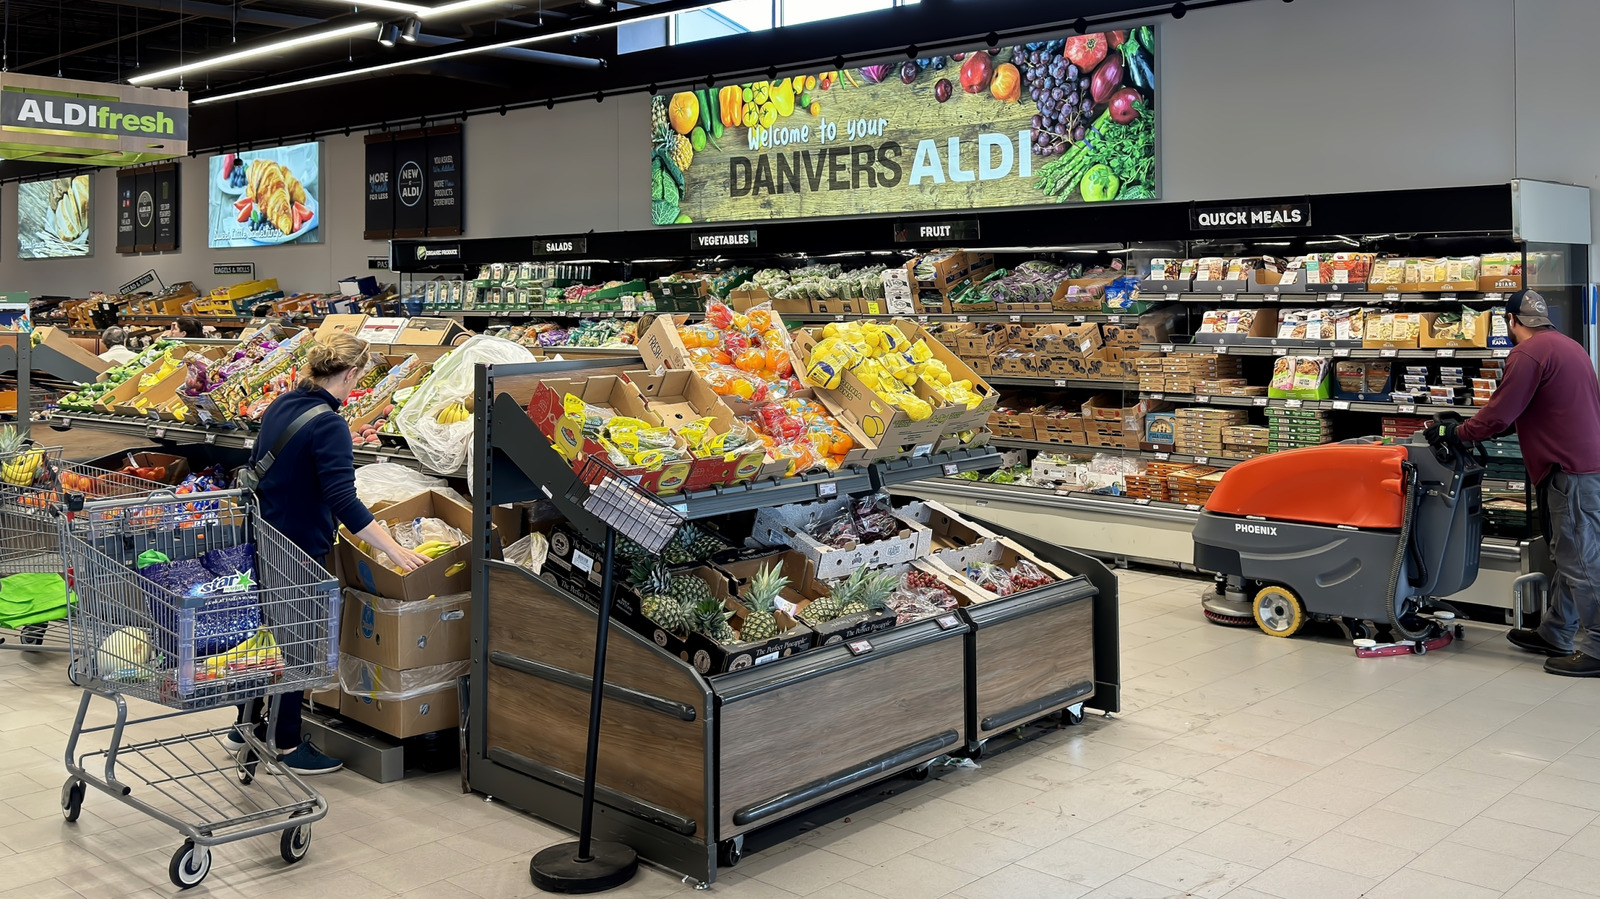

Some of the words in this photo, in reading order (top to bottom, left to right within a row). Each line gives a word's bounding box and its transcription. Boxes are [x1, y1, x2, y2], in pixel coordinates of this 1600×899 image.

[748, 123, 810, 151] Welcome
[820, 117, 837, 144] to
[846, 117, 888, 141] your
[729, 141, 903, 198] DANVERS
[908, 130, 1033, 186] ALDI
[369, 172, 389, 183] MORE
[402, 168, 419, 180] NEW
[402, 186, 420, 198] ALDI
[1198, 211, 1247, 226] QUICK
[1250, 209, 1302, 224] MEALS
[920, 225, 951, 238] FRUIT
[546, 241, 573, 252] SALADS
[698, 234, 749, 246] VEGETABLES
[648, 334, 662, 359] FRESH
[837, 386, 854, 401] ONS
[840, 378, 862, 400] ORNIA
[1235, 523, 1278, 536] PHOENIX
[200, 575, 239, 593] star
[767, 644, 783, 653] Perfect
